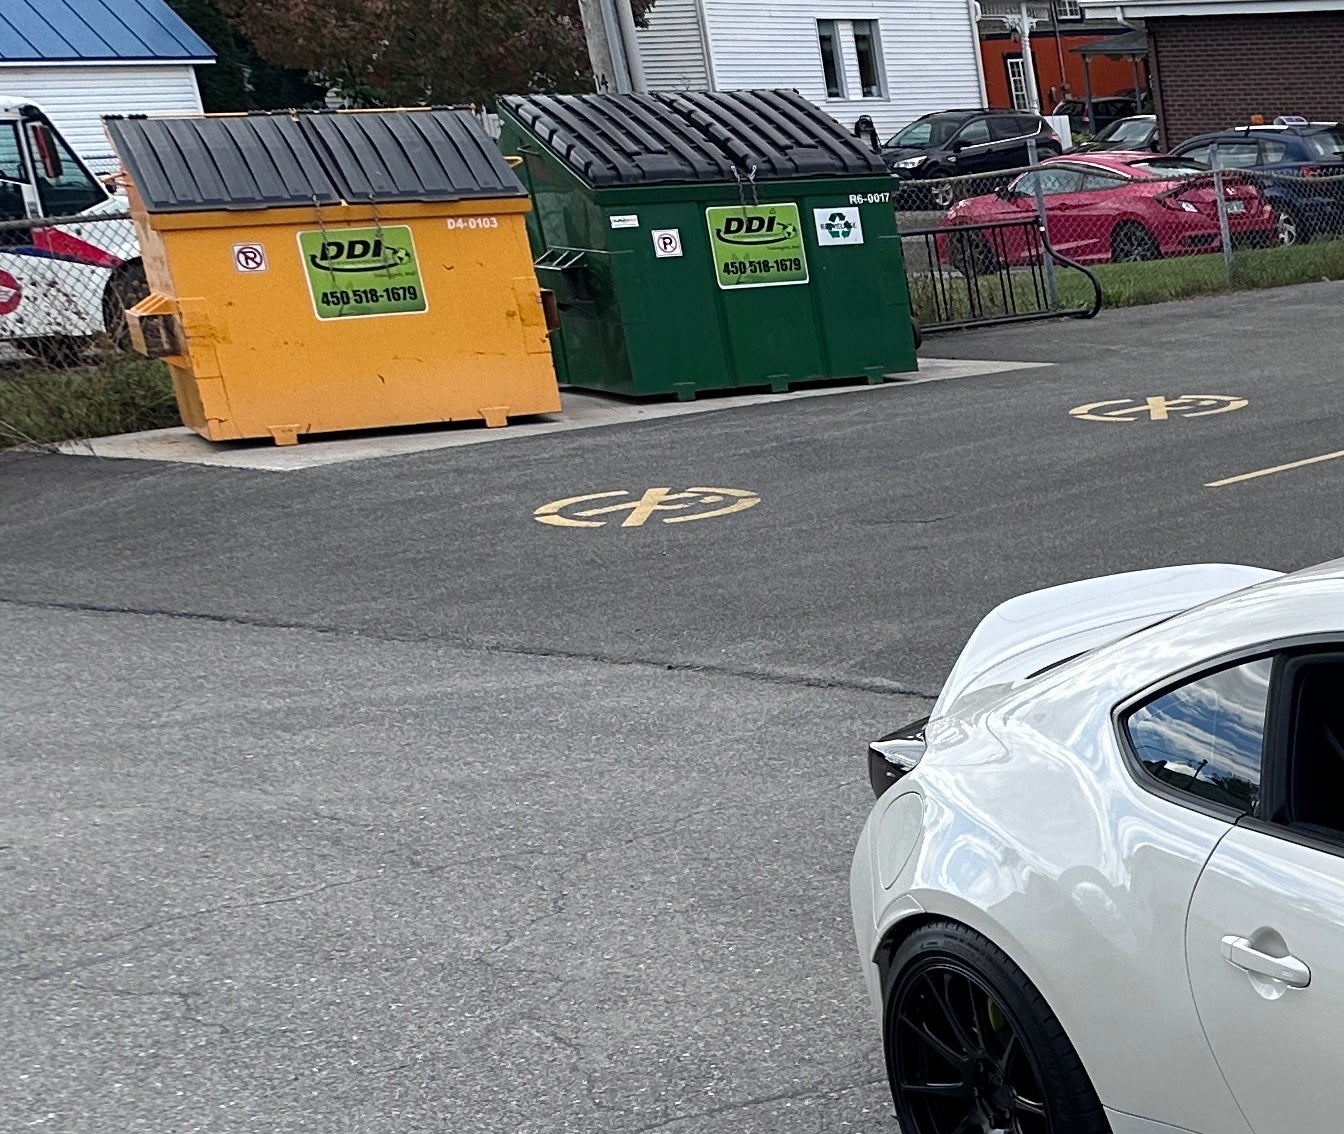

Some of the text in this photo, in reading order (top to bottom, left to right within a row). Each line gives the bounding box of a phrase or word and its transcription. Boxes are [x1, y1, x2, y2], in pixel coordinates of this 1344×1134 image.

[447, 217, 498, 230] D4-0103
[723, 258, 801, 275] 450 518-1679
[321, 285, 418, 307] 450 518-1679
